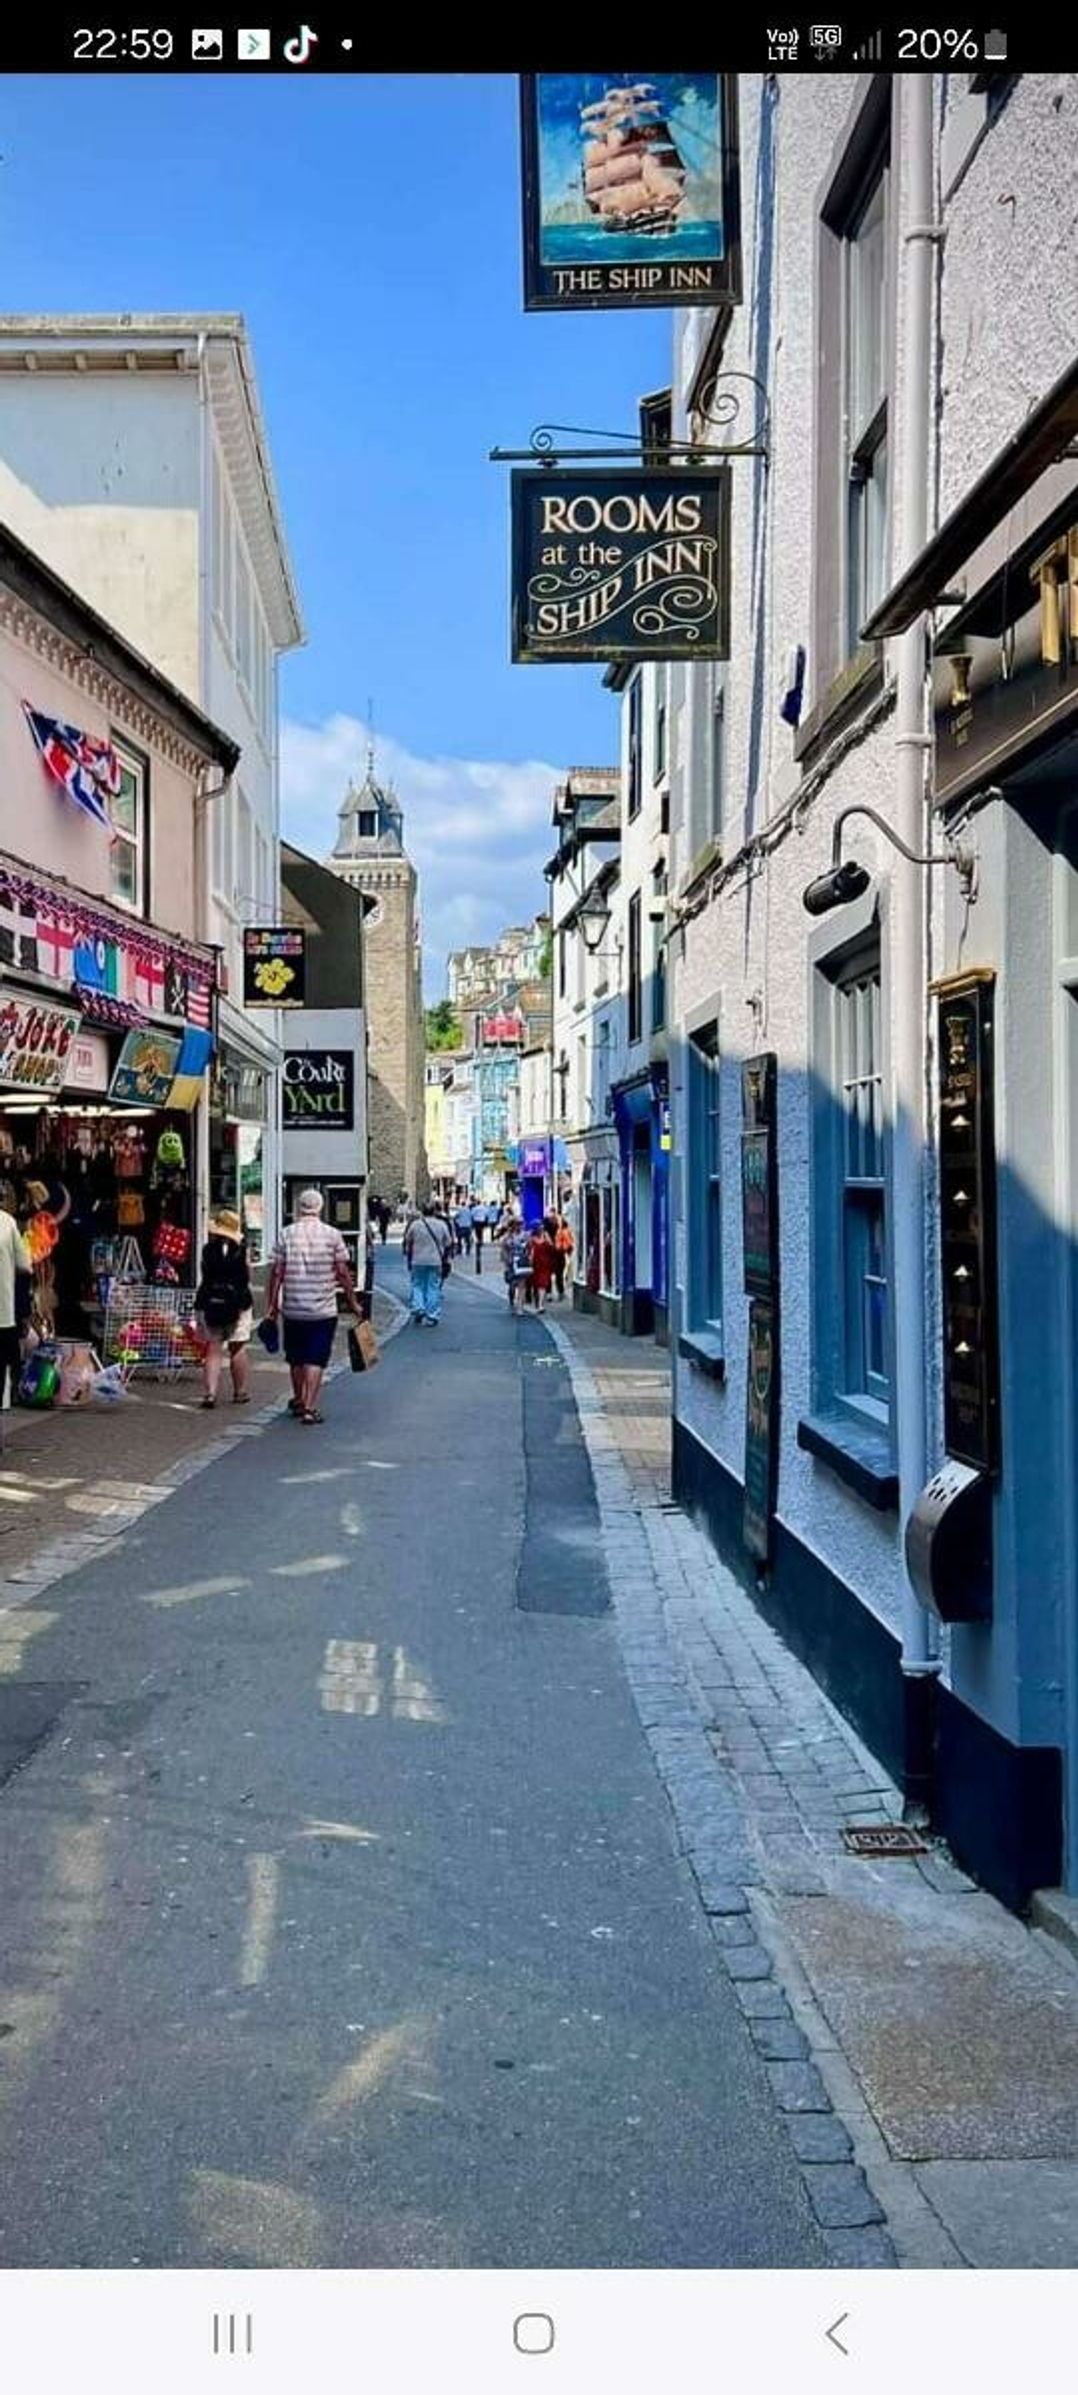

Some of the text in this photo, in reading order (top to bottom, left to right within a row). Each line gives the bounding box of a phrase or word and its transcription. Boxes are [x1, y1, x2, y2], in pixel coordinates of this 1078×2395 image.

[553, 266, 712, 293] THE SHIP INN
[541, 494, 701, 533] ROOMS
[541, 541, 622, 565] at the
[537, 540, 704, 634] SHIP INN
